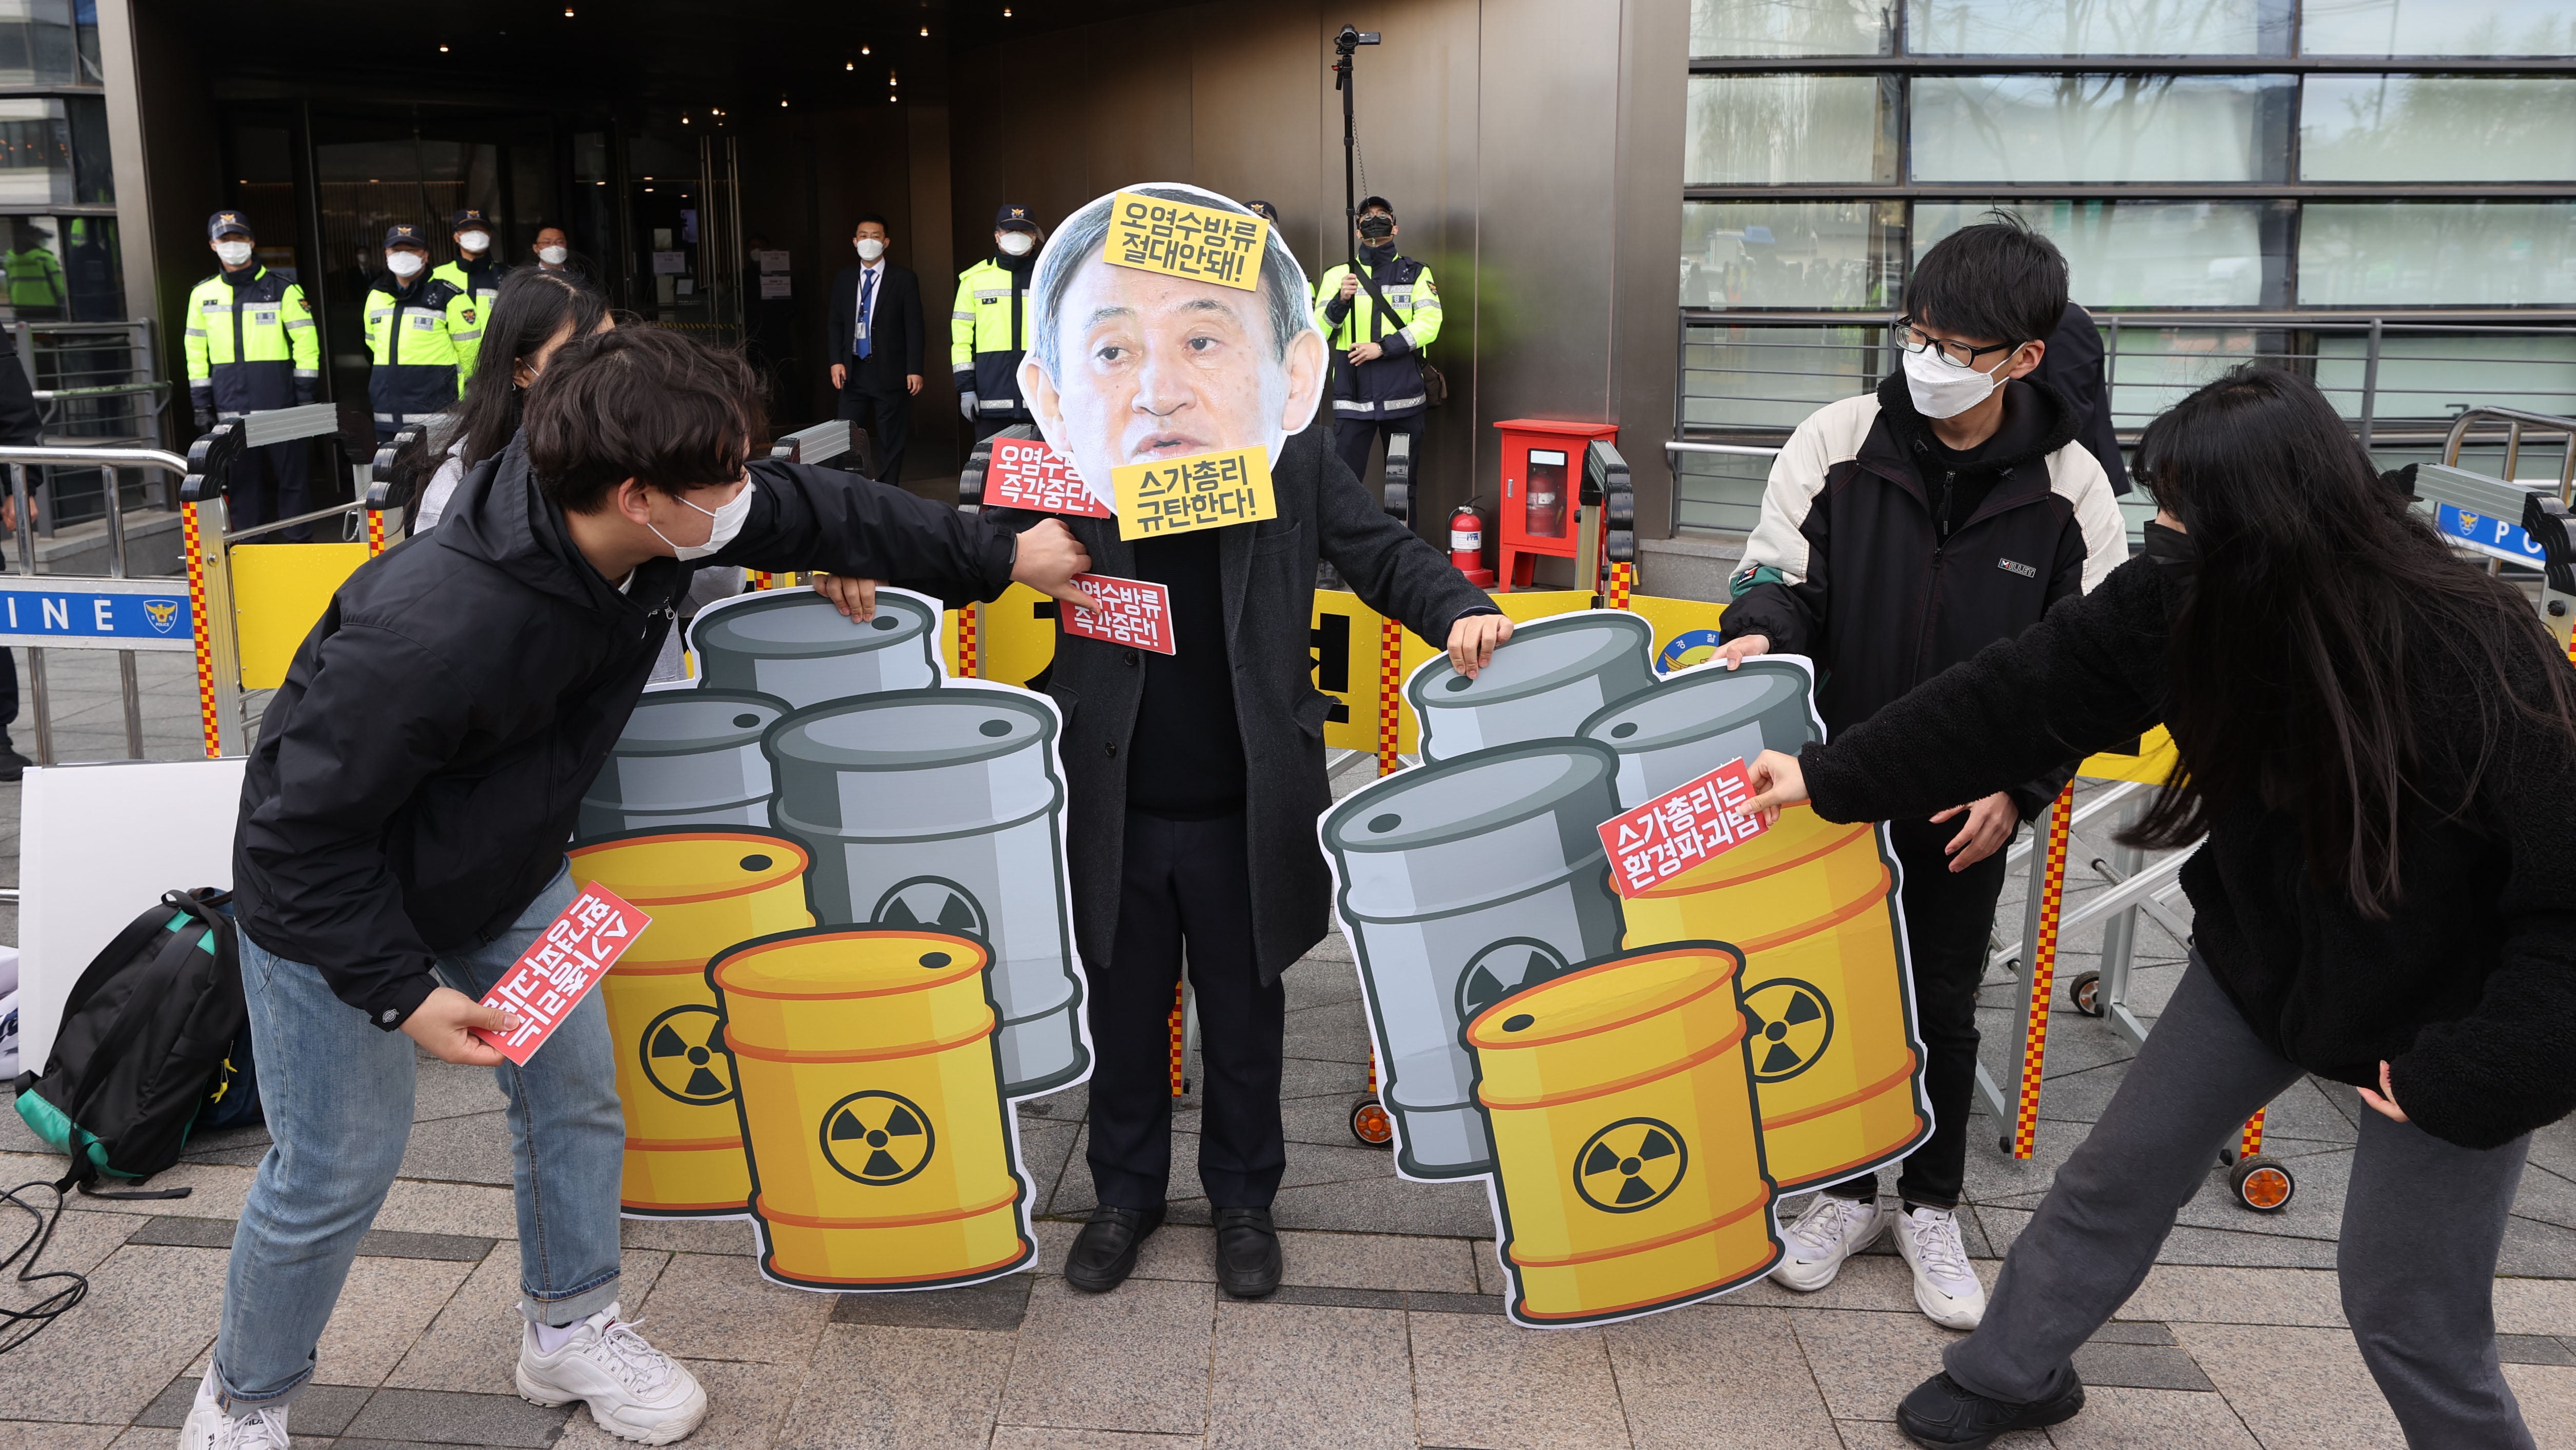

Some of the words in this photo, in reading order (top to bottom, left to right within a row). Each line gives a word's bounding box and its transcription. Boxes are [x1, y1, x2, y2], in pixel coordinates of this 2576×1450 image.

[1120, 203, 1257, 252] 오염수방류
[1122, 232, 1245, 282] 절대안돼!
[1000, 473, 1096, 512] 즉각중단!
[1138, 455, 1247, 497] 스가총리
[1137, 488, 1256, 532] 규탄한다!
[2000, 560, 2034, 576] MILLET
[1069, 579, 1161, 619] 염수방류
[1074, 605, 1159, 646] 즉각중단!
[1617, 776, 1746, 856] 스가총리는
[1622, 805, 1759, 890] 환경파괴범
[507, 910, 628, 1047] 스가총리는
